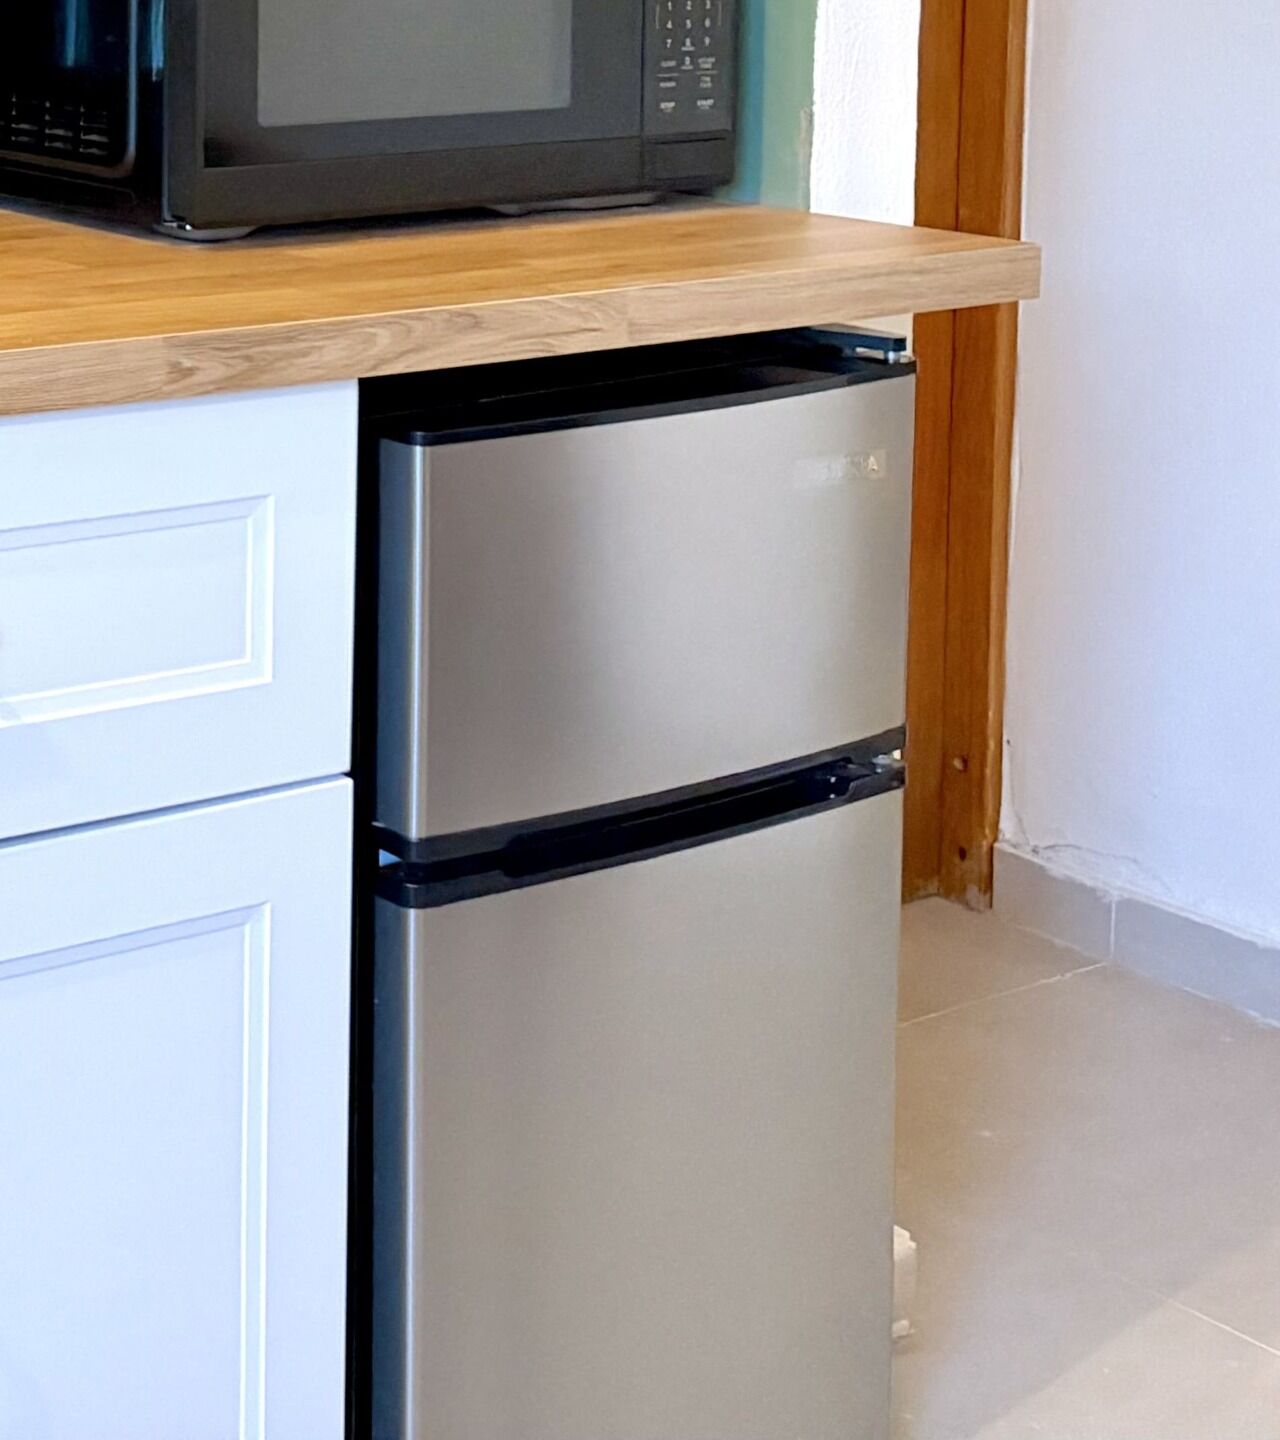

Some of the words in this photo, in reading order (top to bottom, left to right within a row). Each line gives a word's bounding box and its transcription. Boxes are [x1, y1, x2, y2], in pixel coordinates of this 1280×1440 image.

[667, 0, 673, 12] 1
[685, 0, 692, 11] 2
[665, 19, 673, 29] 4
[685, 19, 692, 29] 5
[704, 17, 711, 28] 6
[666, 38, 673, 49] 7
[703, 36, 711, 47] 9
